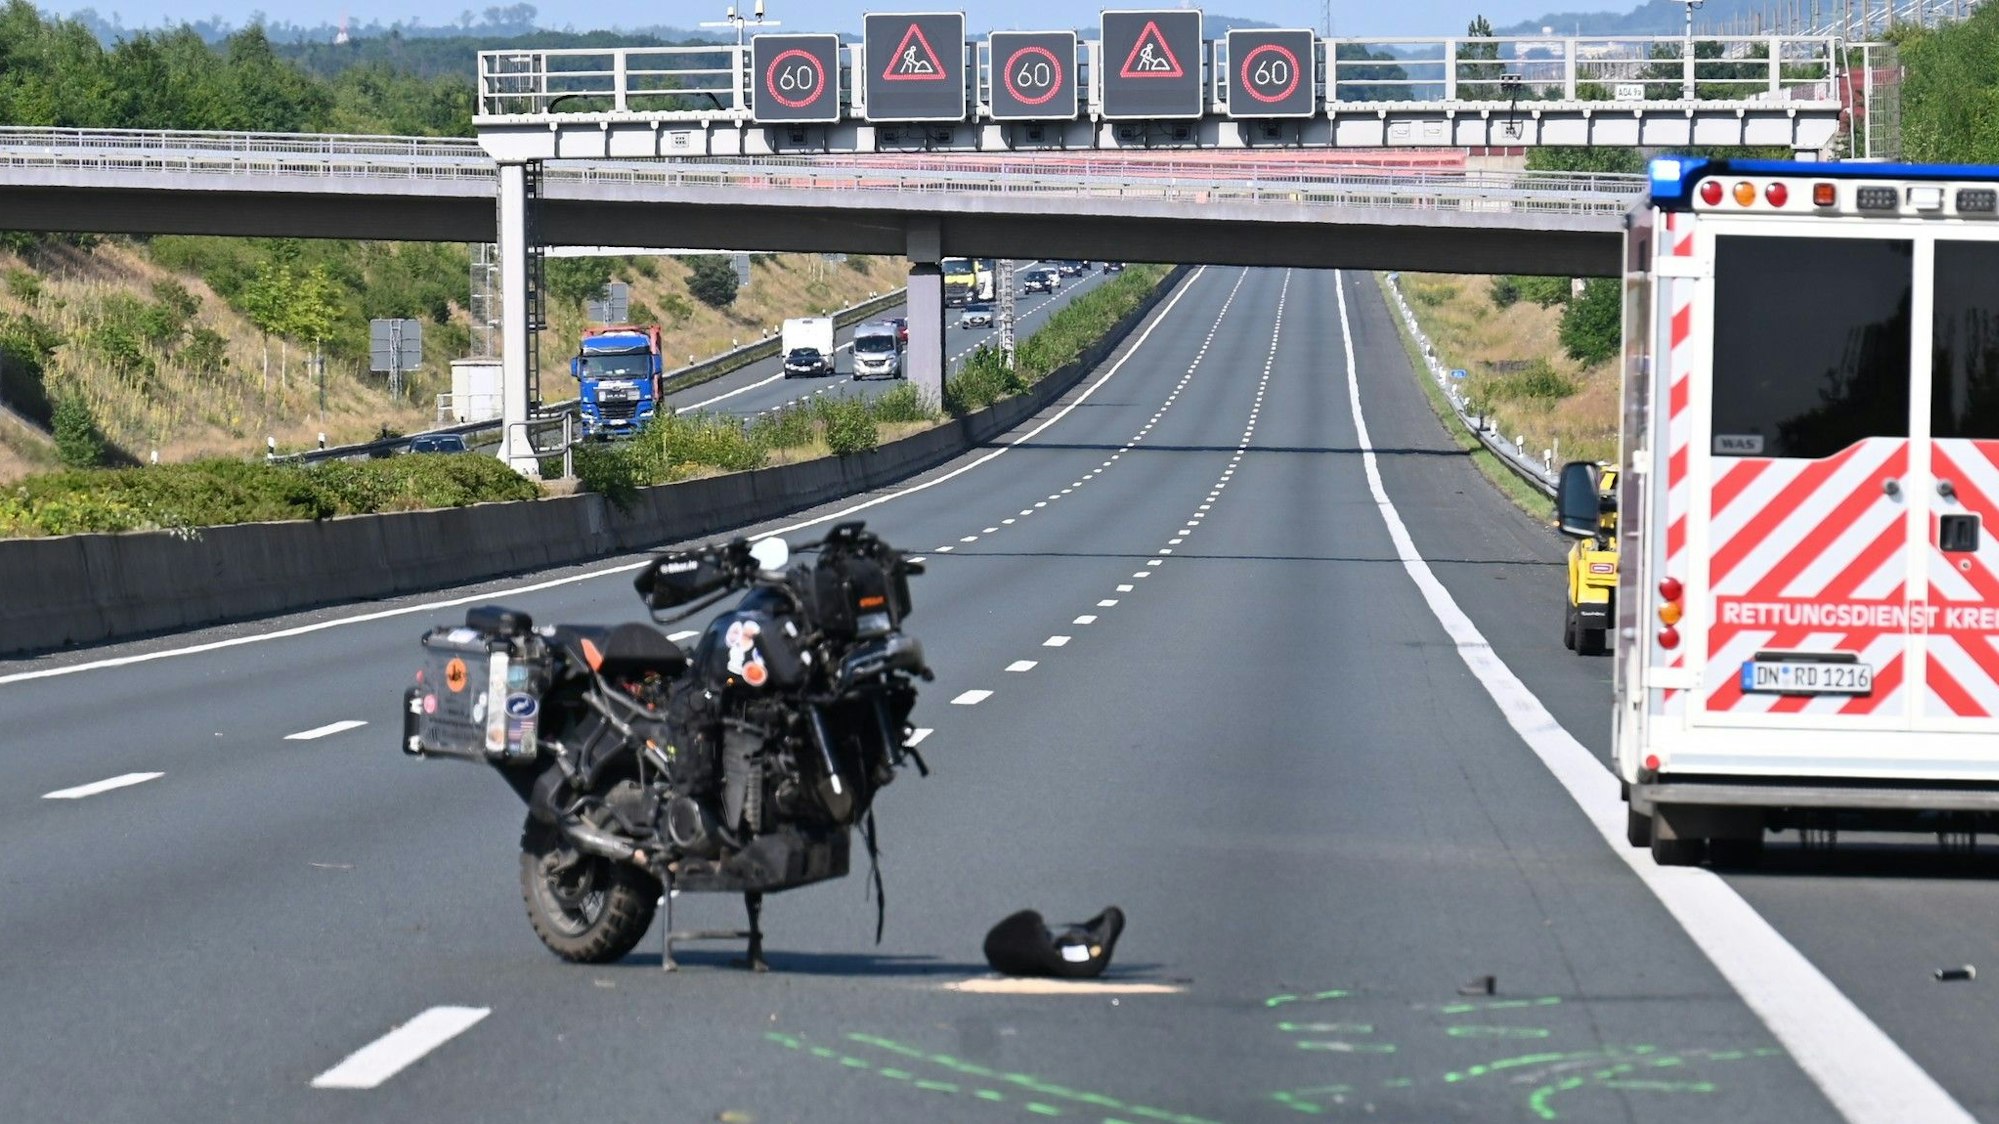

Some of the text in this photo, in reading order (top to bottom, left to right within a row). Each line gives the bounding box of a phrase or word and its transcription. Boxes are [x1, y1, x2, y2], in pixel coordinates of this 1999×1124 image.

[780, 65, 812, 90] 60
[1017, 62, 1050, 87] 60
[1255, 60, 1288, 85] 60
[1721, 438, 1755, 449] WAS
[1723, 603, 1940, 629] RETTUNGSDIENST
[1823, 668, 1869, 687] 1216
